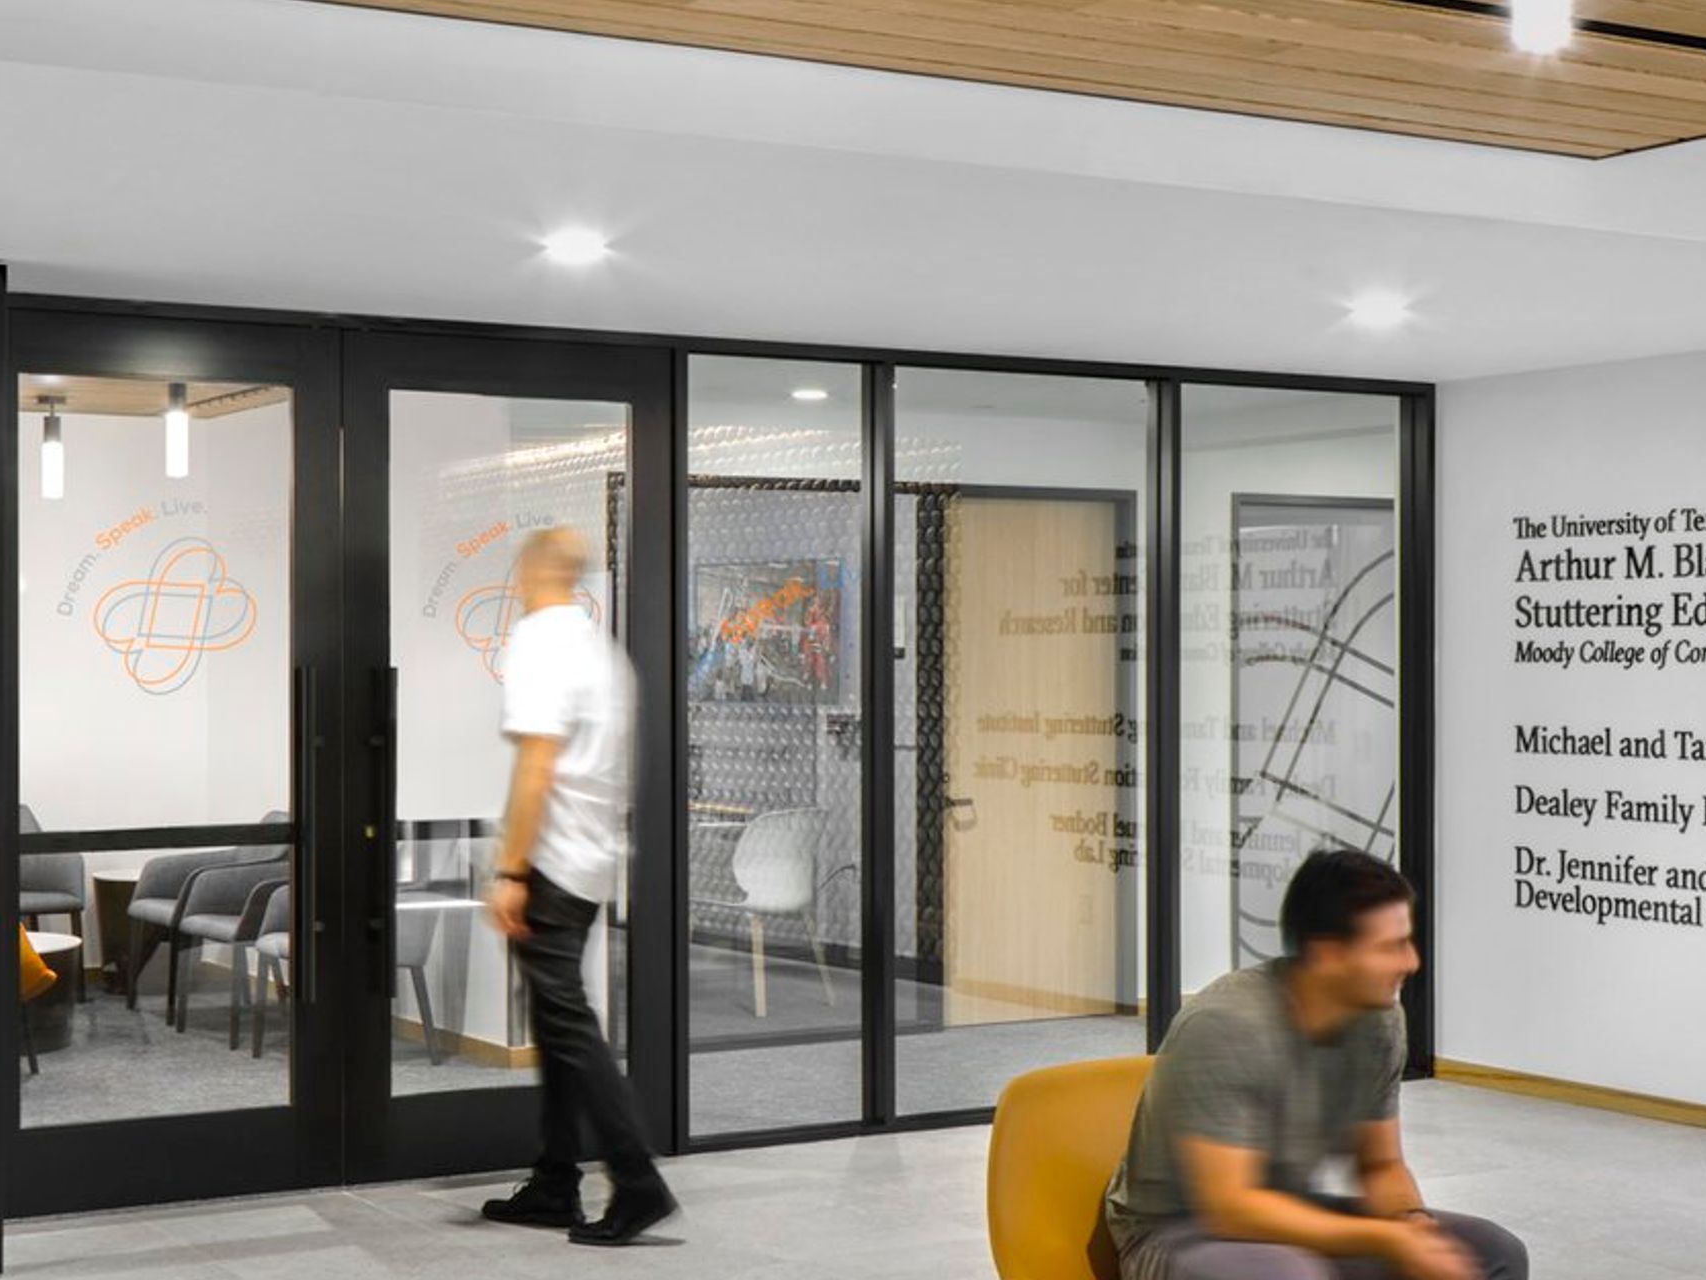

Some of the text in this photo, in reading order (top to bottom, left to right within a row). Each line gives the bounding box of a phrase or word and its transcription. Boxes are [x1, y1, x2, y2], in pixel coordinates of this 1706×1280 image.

[1512, 516, 1548, 540] The
[1550, 511, 1652, 542] University
[1653, 507, 1678, 534] of
[1514, 547, 1617, 583] Arthur
[1624, 544, 1664, 580] M.
[1514, 594, 1664, 639] Stuttering
[1514, 640, 1576, 670] Moody
[1578, 639, 1646, 671] College
[1649, 638, 1672, 671] of
[1514, 724, 1613, 757] Michael
[1618, 728, 1668, 760] and
[1514, 784, 1598, 828] Dealey
[1604, 789, 1696, 835] Family
[1514, 845, 1552, 877] Dr.
[1555, 849, 1659, 887] Jennifer
[1514, 878, 1704, 928] Developmental
